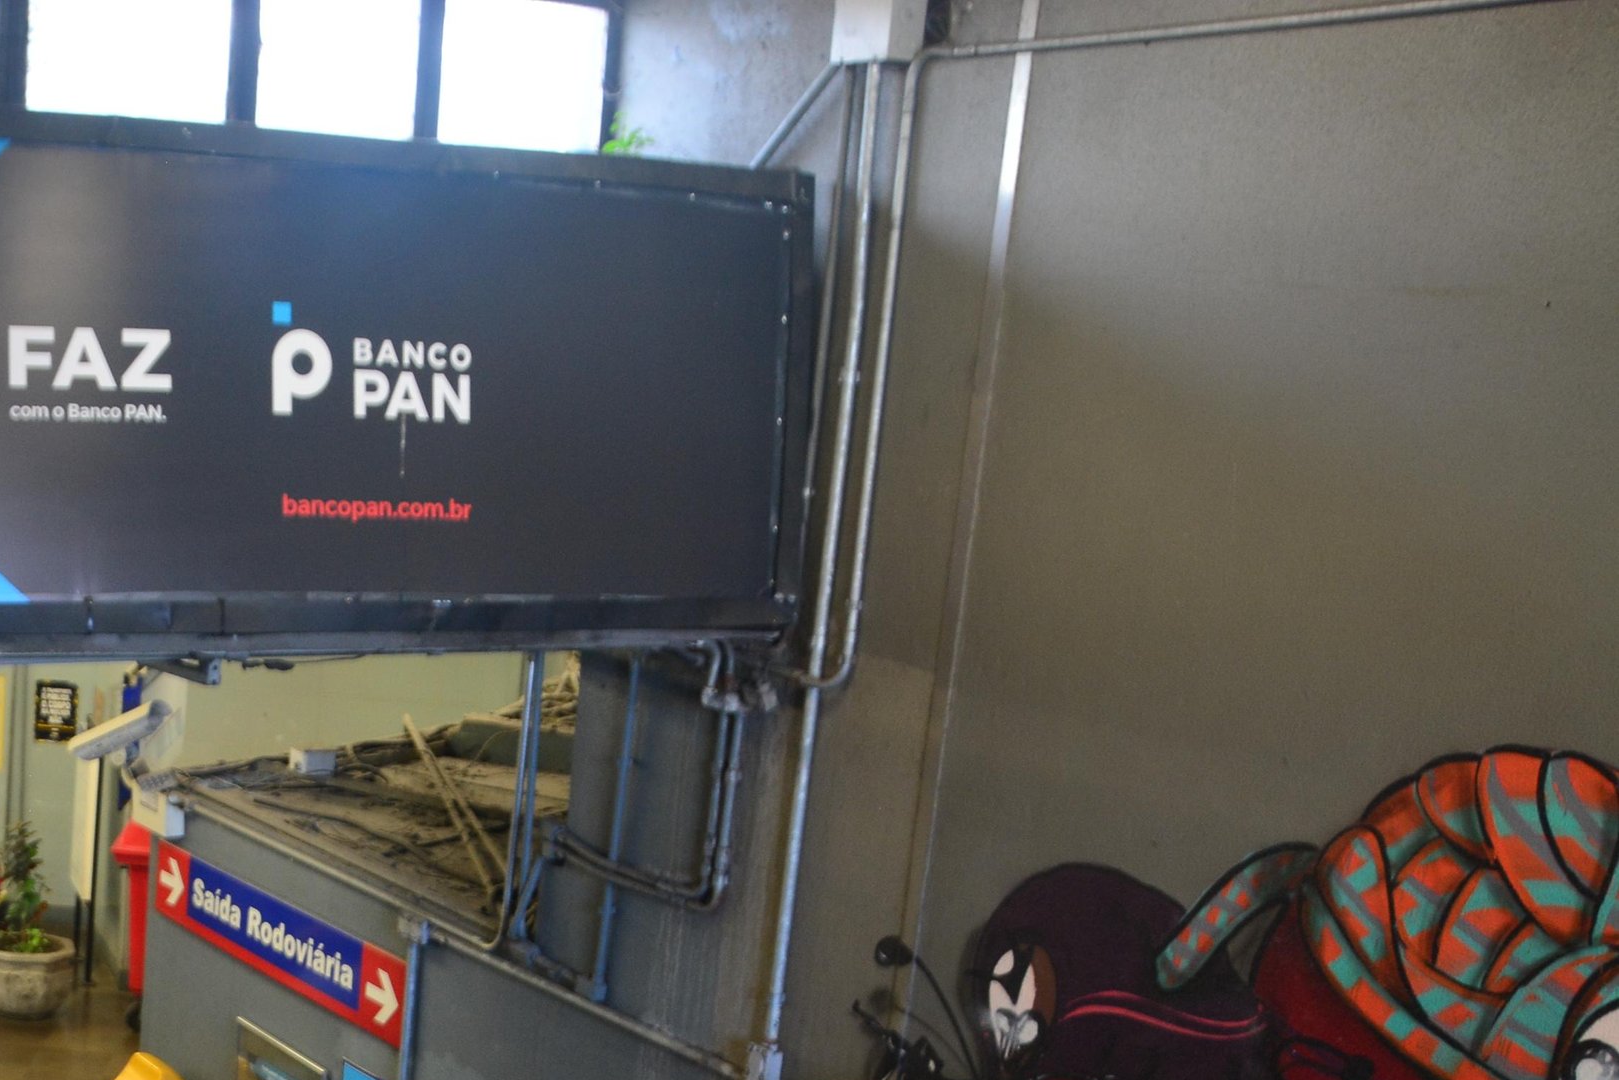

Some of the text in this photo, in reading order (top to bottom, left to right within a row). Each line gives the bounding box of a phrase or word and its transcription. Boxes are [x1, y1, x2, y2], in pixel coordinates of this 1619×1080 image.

[7, 325, 172, 392] FAZ
[353, 337, 472, 370] BANCO
[10, 403, 167, 423] com o Banco PAN.
[353, 369, 472, 423] PAN
[282, 493, 472, 523] bancopan.com.br
[192, 877, 354, 991] Saída Rodoviária
